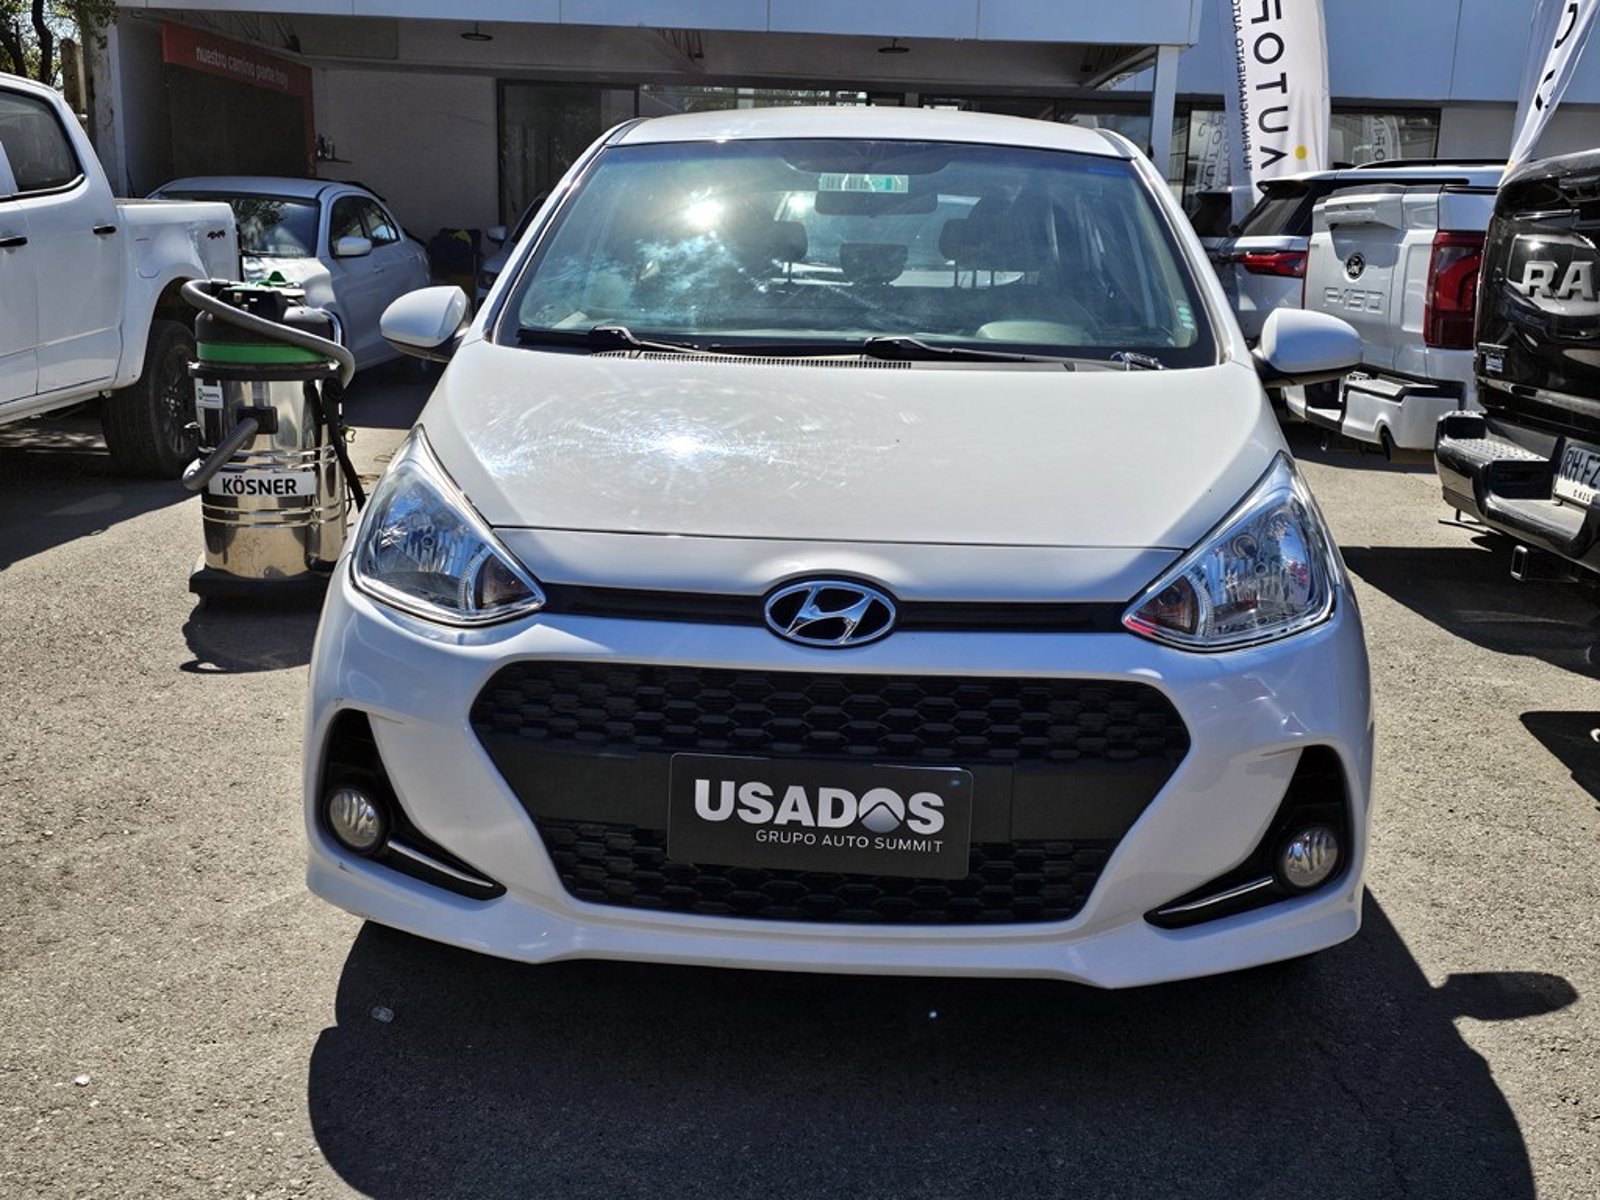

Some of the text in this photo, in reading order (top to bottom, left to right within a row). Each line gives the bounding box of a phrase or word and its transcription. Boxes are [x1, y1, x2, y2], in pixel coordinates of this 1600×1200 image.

[195, 46, 227, 68] nuestro
[228, 55, 256, 76] camino
[256, 63, 275, 83] parte
[222, 473, 297, 496] KÖSNER
[694, 778, 945, 835] USADOS
[755, 829, 944, 853] GRUPO AUTO SUMMIT
